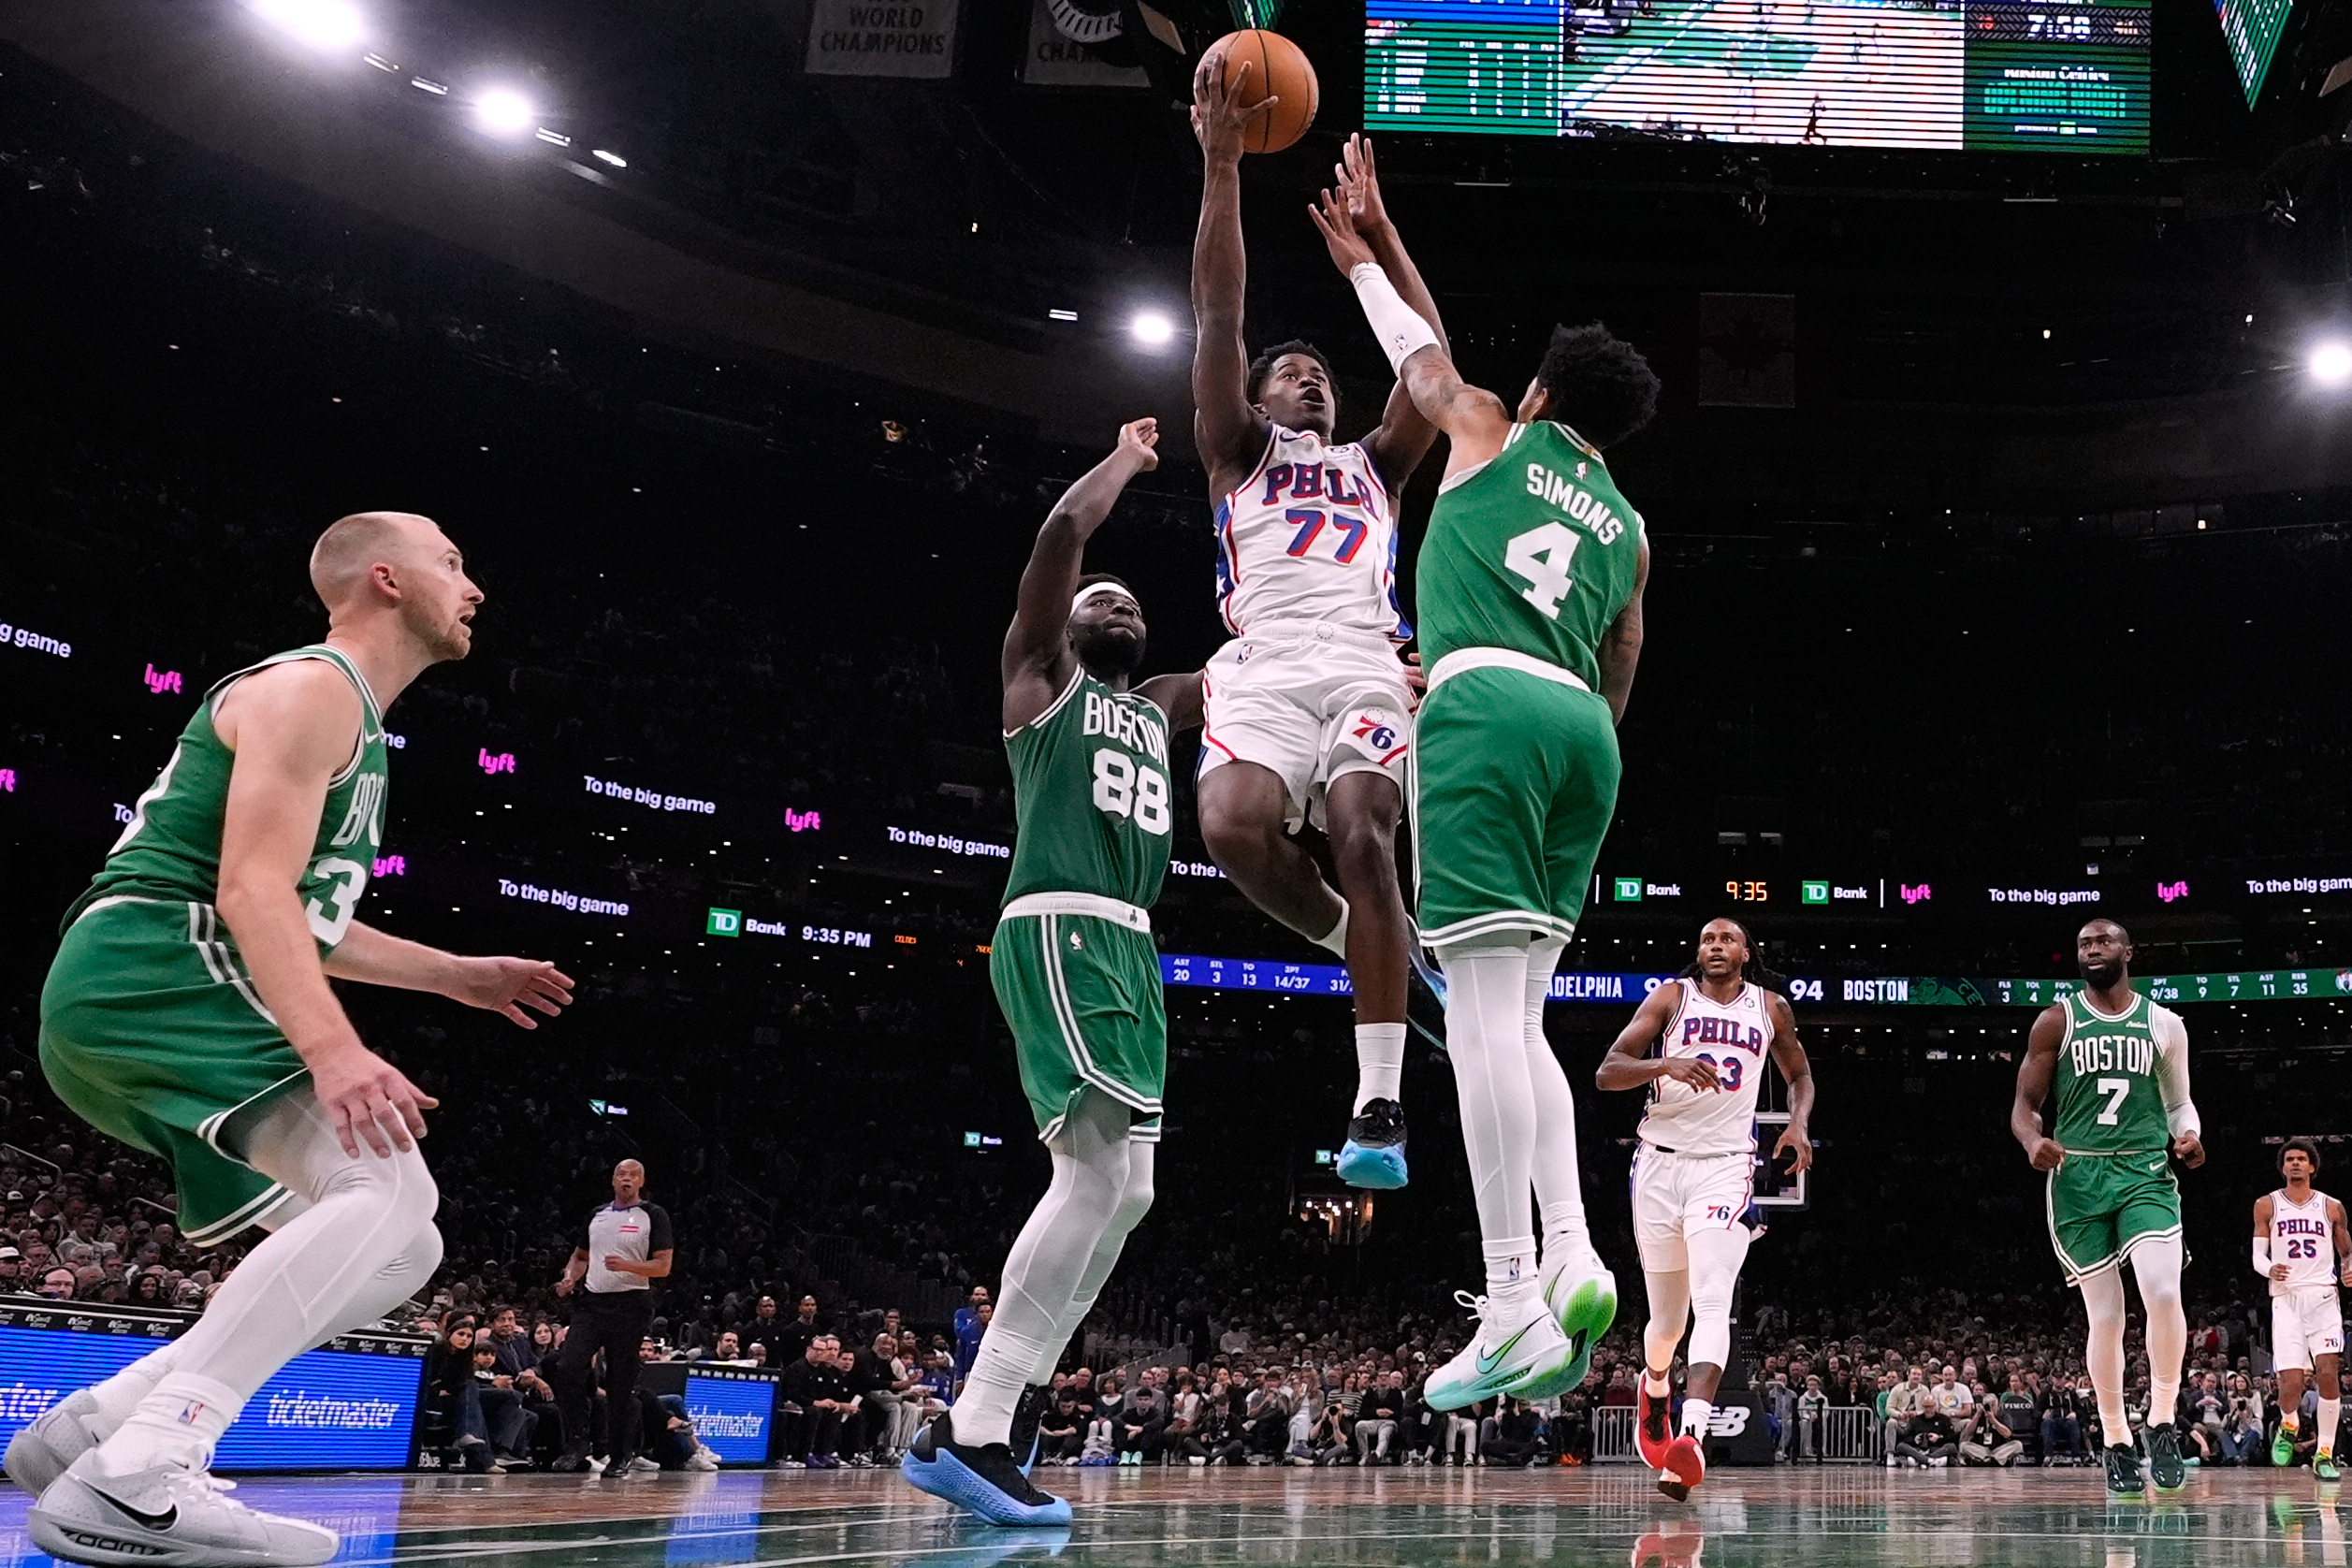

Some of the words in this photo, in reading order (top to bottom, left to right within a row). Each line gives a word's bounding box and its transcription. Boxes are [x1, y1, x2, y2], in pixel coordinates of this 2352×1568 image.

[849, 7, 924, 29] WORLD
[820, 30, 947, 56] CHAMPIONS
[1262, 461, 1381, 524] PHLA
[1526, 462, 1624, 546] SIMONS
[1285, 508, 1369, 564] 77
[1503, 520, 1582, 621] 4
[13, 628, 72, 659] game
[144, 662, 182, 694] lyft
[1082, 691, 1169, 774] BOSTON
[1353, 714, 1397, 750] 76
[478, 748, 516, 775] lyft
[0, 768, 16, 793] ft
[1092, 748, 1170, 836] 88
[584, 775, 603, 793] To
[605, 780, 633, 801] the
[634, 787, 662, 809] big
[664, 795, 717, 815] game
[113, 803, 135, 824] To
[784, 807, 821, 833] lyft
[887, 826, 907, 843] To
[908, 830, 936, 848] the
[937, 834, 964, 854] big
[965, 840, 1010, 859] game
[373, 855, 406, 878] yft
[1169, 860, 1189, 876] To
[1190, 863, 1218, 878] the
[499, 878, 519, 897] To
[521, 883, 550, 903] the
[551, 889, 579, 911] big
[579, 896, 630, 917] game
[1617, 880, 1641, 898] TD
[1646, 883, 1681, 897] Bank
[1726, 880, 1768, 902] 9:35
[1804, 884, 1828, 901] TD
[1833, 886, 1867, 899] Bank
[1900, 883, 1932, 905] lyft
[1989, 888, 2006, 902] To
[2008, 888, 2033, 903] the
[2034, 889, 2057, 906] big
[2058, 890, 2101, 906] game
[2157, 880, 2189, 903] lyft
[2246, 879, 2265, 894] To
[2266, 878, 2292, 893] the
[2294, 877, 2318, 893] big
[2319, 877, 2352, 893] gam
[711, 911, 738, 932] TD
[746, 918, 787, 936] Bank
[802, 925, 840, 945] 9:35
[843, 930, 872, 949] PM
[1173, 958, 1190, 967] AST
[1210, 960, 1224, 969] STL
[1242, 962, 1256, 971] TO
[1173, 968, 1190, 982] 20
[1212, 971, 1221, 983] 3
[1242, 973, 1257, 986] 13
[1274, 975, 1311, 990] 14/37
[1329, 979, 1353, 993] 31/
[1546, 976, 1623, 998] ADELPHIA
[1643, 977, 1676, 994] 9
[1789, 979, 1824, 1001] 94
[1843, 980, 1909, 1002] BOSTON
[2001, 991, 2011, 1003] 3
[2028, 991, 2039, 1003] 4
[2150, 987, 2179, 1001] 9/38
[2198, 986, 2208, 998] 9
[2230, 985, 2239, 997] 7
[2262, 983, 2275, 996] 11
[2292, 982, 2308, 995] 35
[2025, 980, 2040, 990] TOL
[2196, 976, 2208, 984] TO
[2258, 973, 2274, 982] AST
[1681, 1016, 1763, 1058] PHILA
[2070, 1035, 2154, 1078] BOSTON
[2097, 1078, 2130, 1125] 7
[1706, 1205, 1731, 1221] 76
[2277, 1218, 2326, 1238] PHILA
[2287, 1239, 2317, 1259] 25
[2324, 1338, 2339, 1348] 76
[267, 1388, 400, 1429] ticketmaster
